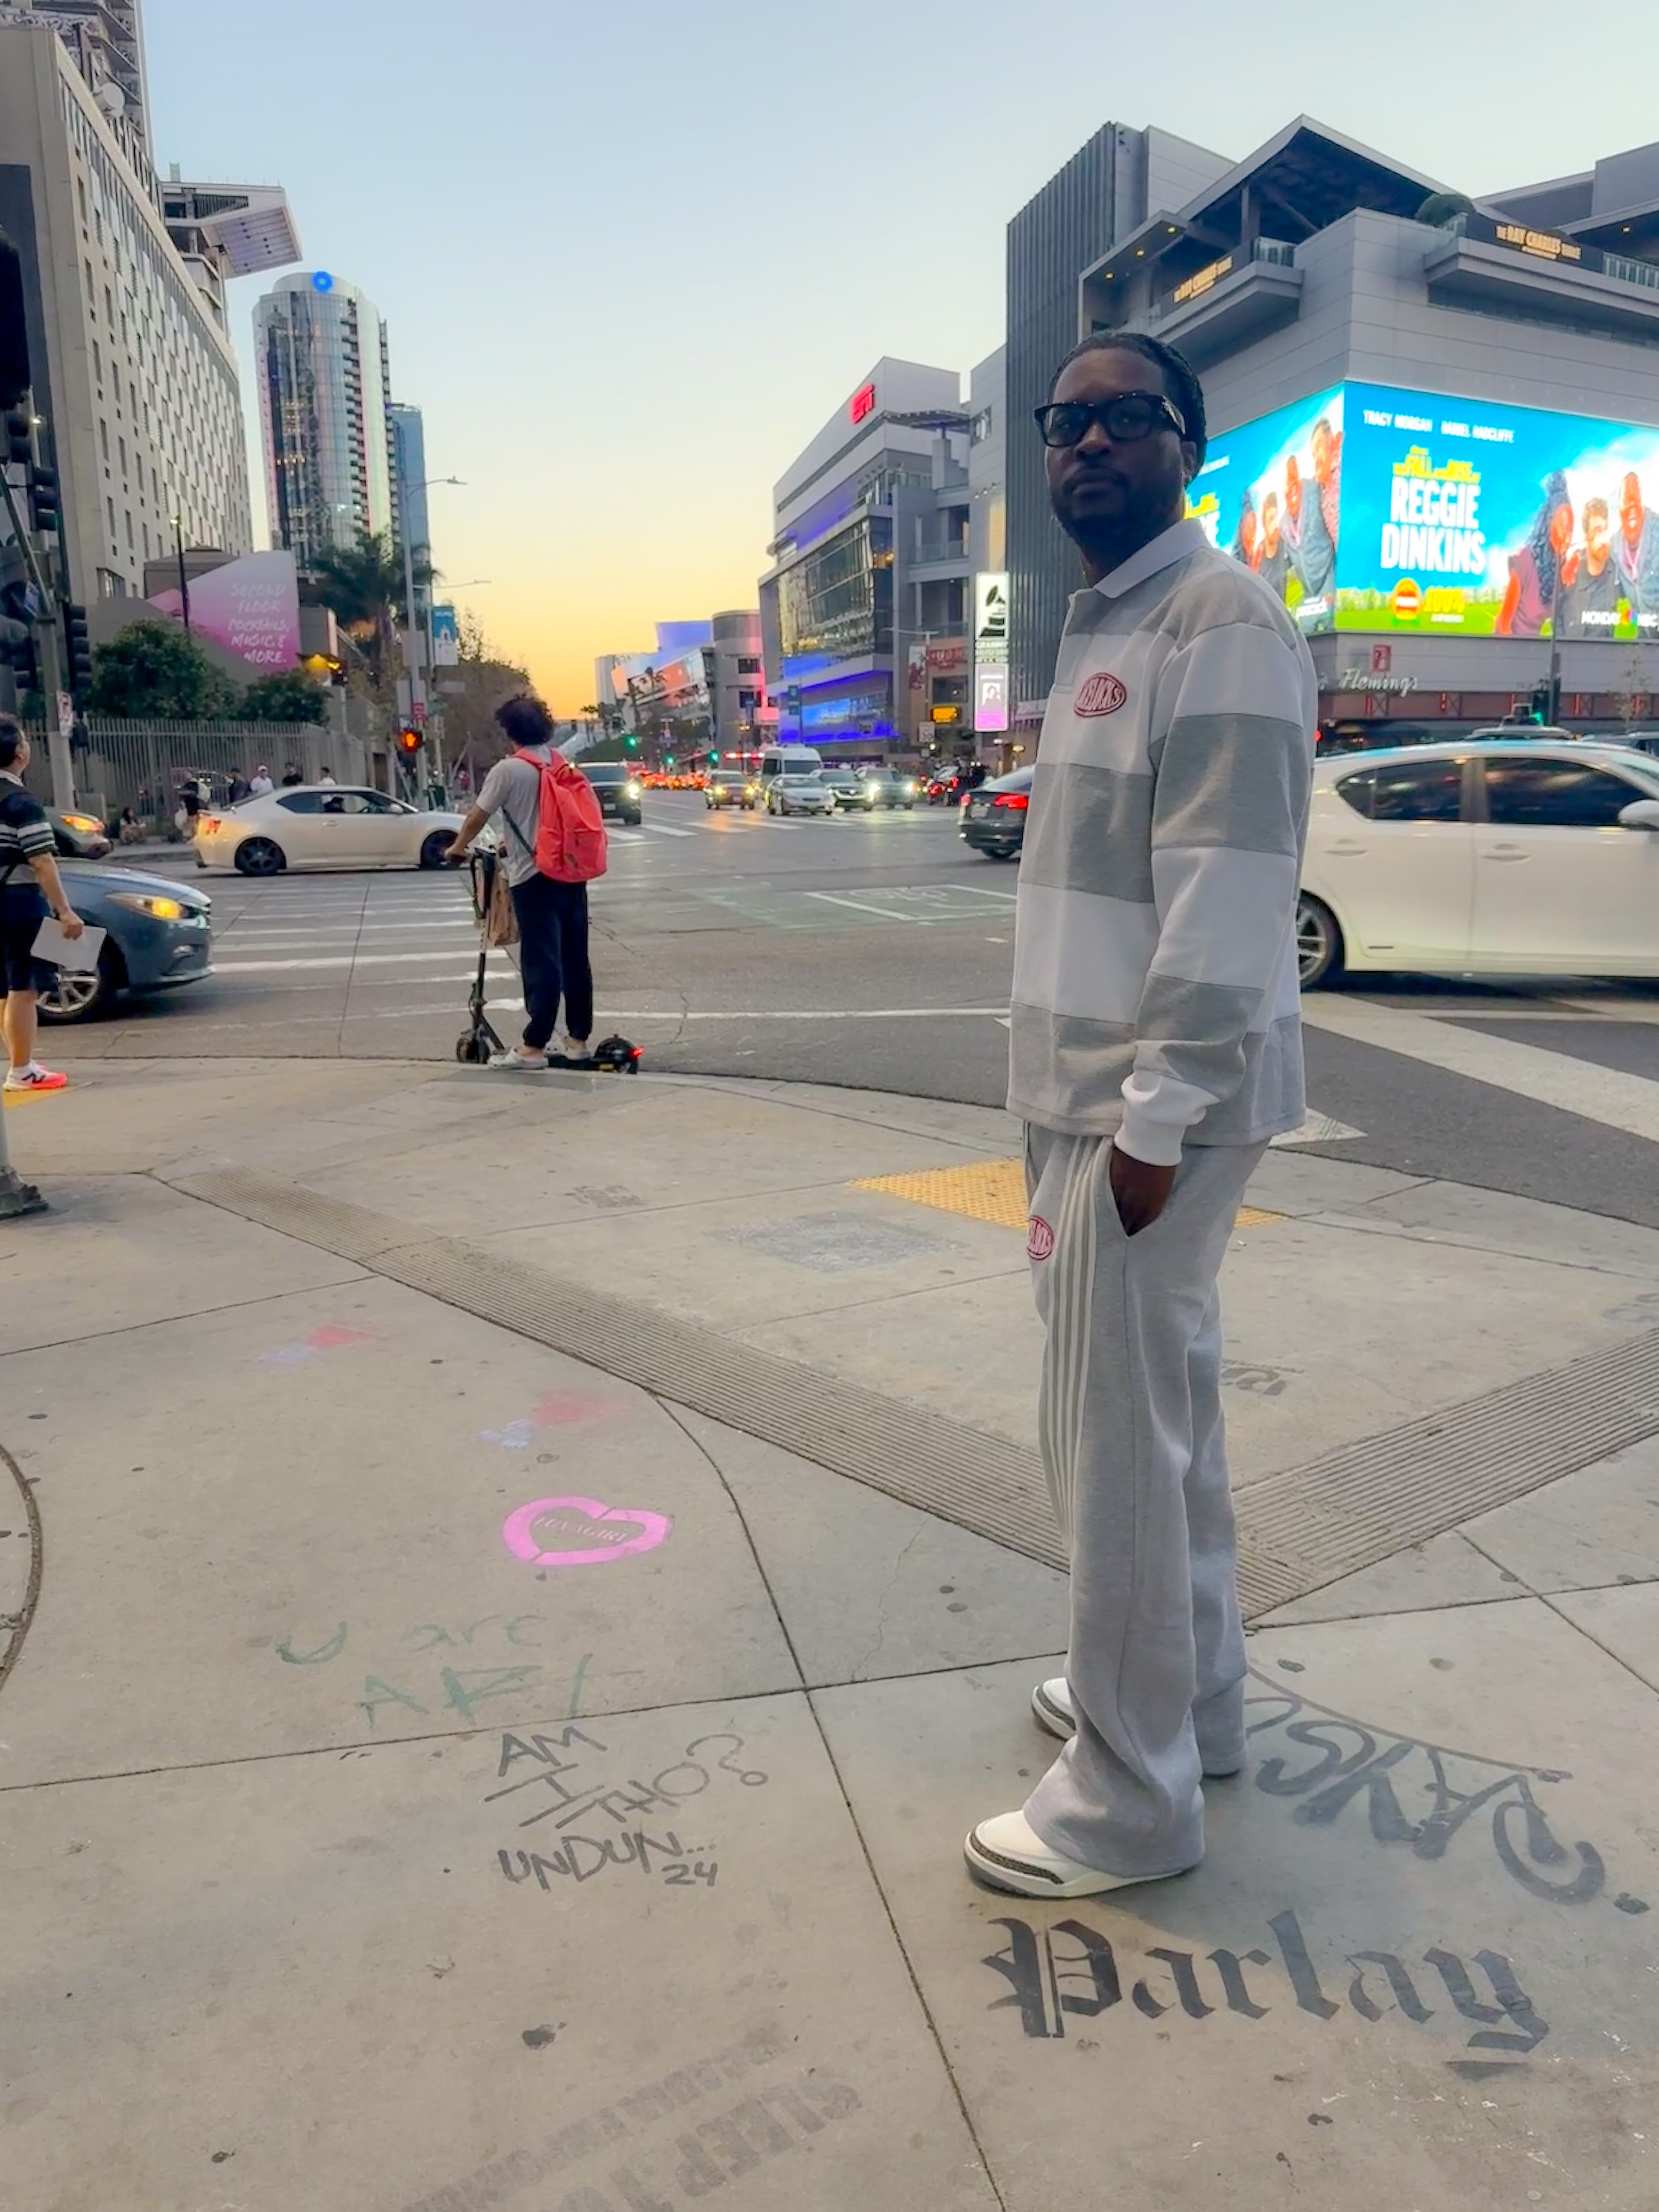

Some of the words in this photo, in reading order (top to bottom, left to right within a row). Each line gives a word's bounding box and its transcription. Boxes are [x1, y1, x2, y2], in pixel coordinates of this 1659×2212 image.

[1390, 476, 1481, 530] REGGIE
[1380, 522, 1486, 575] DINKINS
[498, 1726, 607, 1777] AM
[661, 1861, 718, 1887] 24
[981, 1908, 1549, 2054] Parlay
